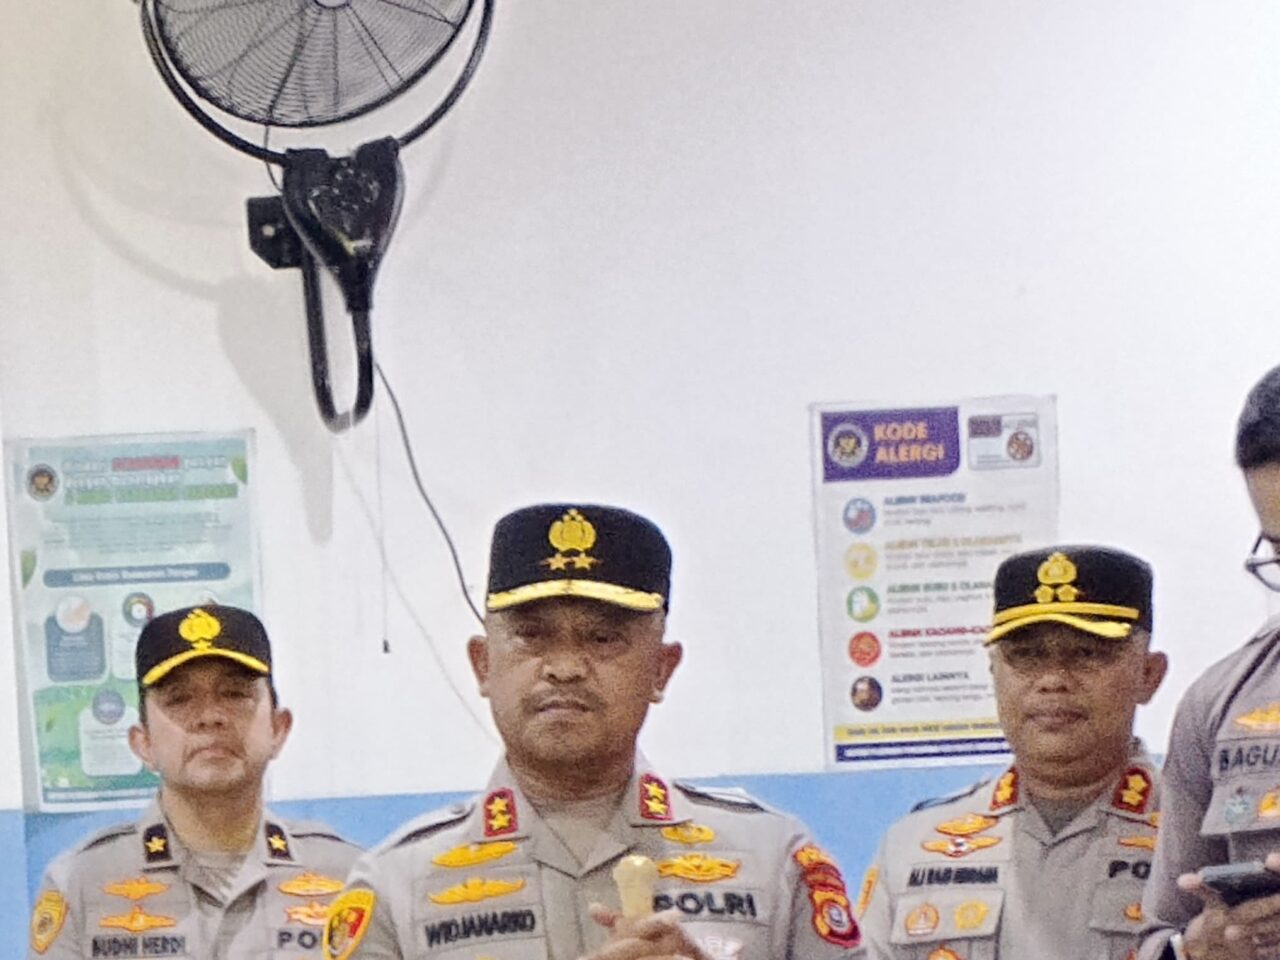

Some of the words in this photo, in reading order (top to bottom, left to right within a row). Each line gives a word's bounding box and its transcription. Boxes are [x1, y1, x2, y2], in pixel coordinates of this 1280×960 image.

[874, 422, 928, 441] KODE
[875, 444, 945, 463] ALERGI
[652, 892, 757, 917] POLRI
